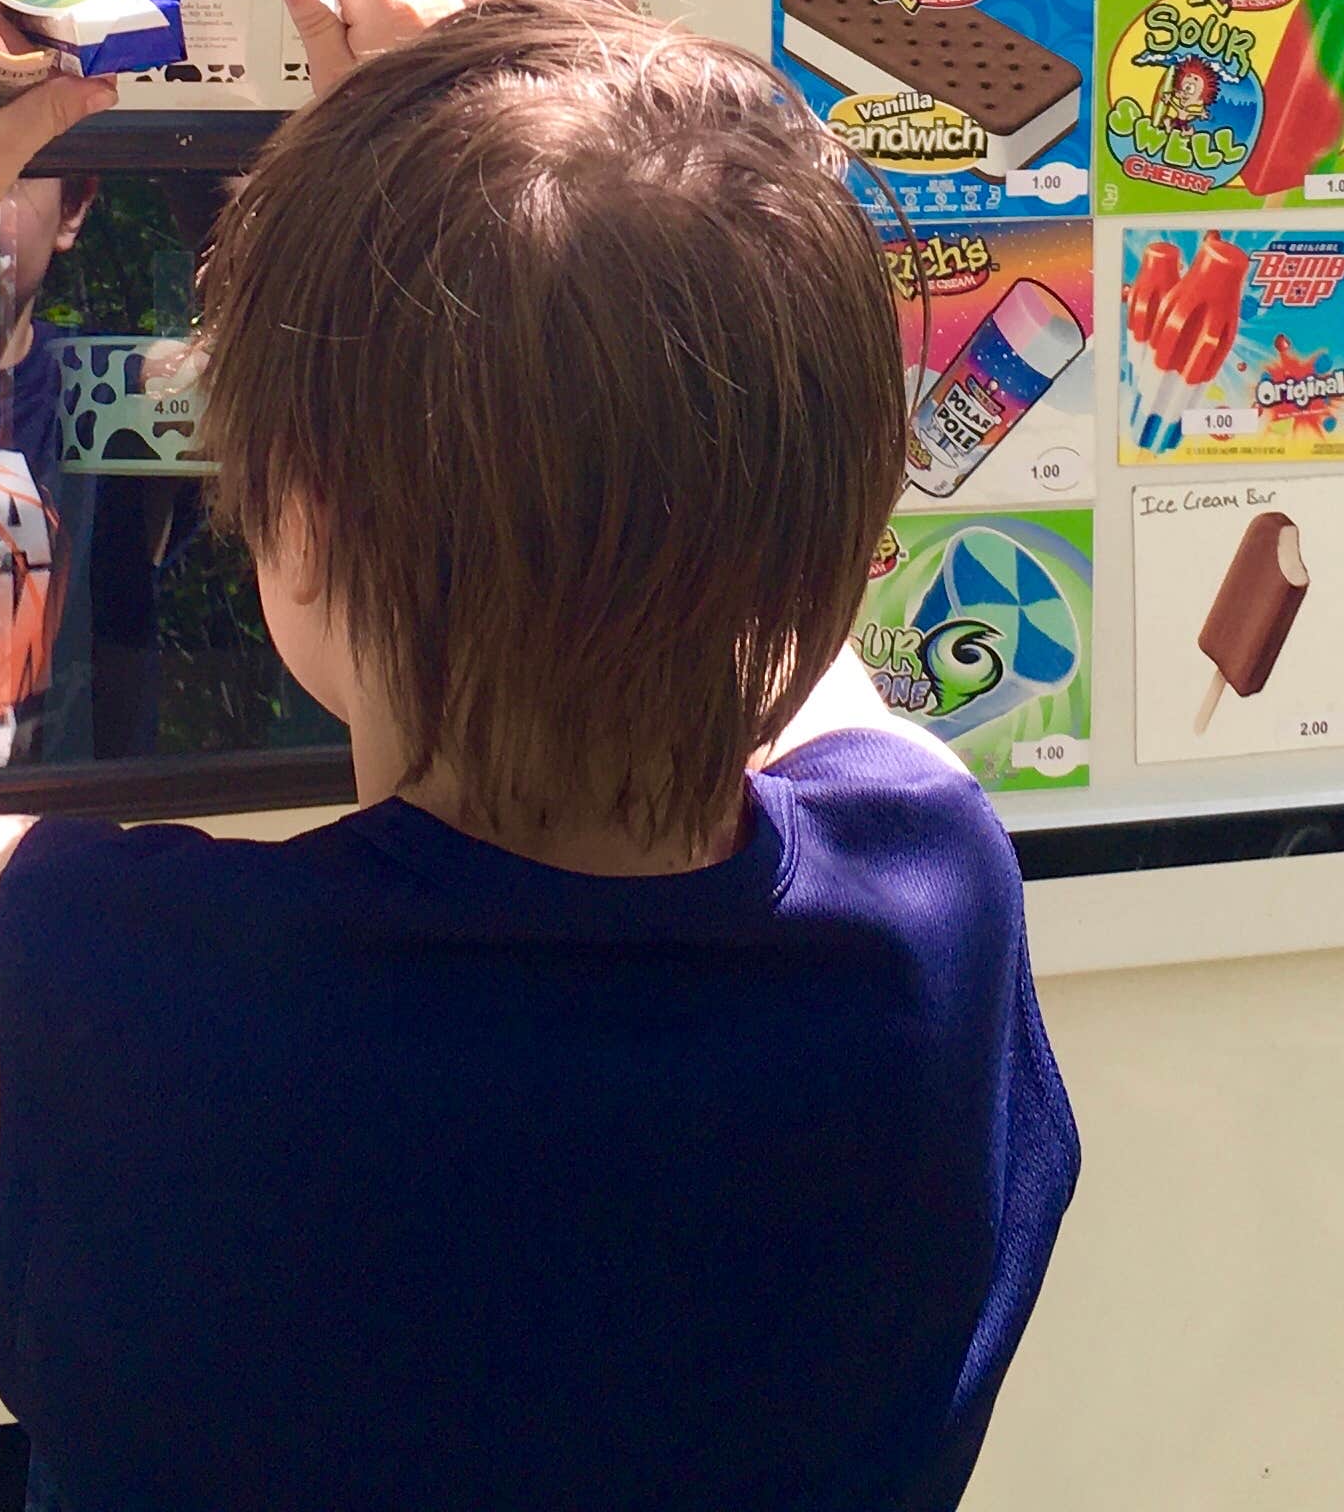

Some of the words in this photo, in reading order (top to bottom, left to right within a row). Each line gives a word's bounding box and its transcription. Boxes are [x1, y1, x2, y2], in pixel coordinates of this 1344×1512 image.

[1146, 4, 1256, 78] SOUR
[855, 91, 934, 121] Vanilla
[1108, 96, 1248, 170] SWELL
[1031, 174, 1061, 190] 1.00
[1123, 154, 1216, 196] CHERRY
[1263, 280, 1336, 306] POP
[153, 398, 190, 416] 4.00
[945, 388, 992, 431] POLAR
[1204, 414, 1233, 428] 1.00
[936, 408, 977, 451] POLE
[1031, 464, 1061, 479] 1.00
[1139, 496, 1178, 517] Ice
[1183, 490, 1240, 512] Cream
[1246, 487, 1278, 506] Bar
[1300, 720, 1329, 737] 2.00
[1035, 745, 1065, 761] 1.00
